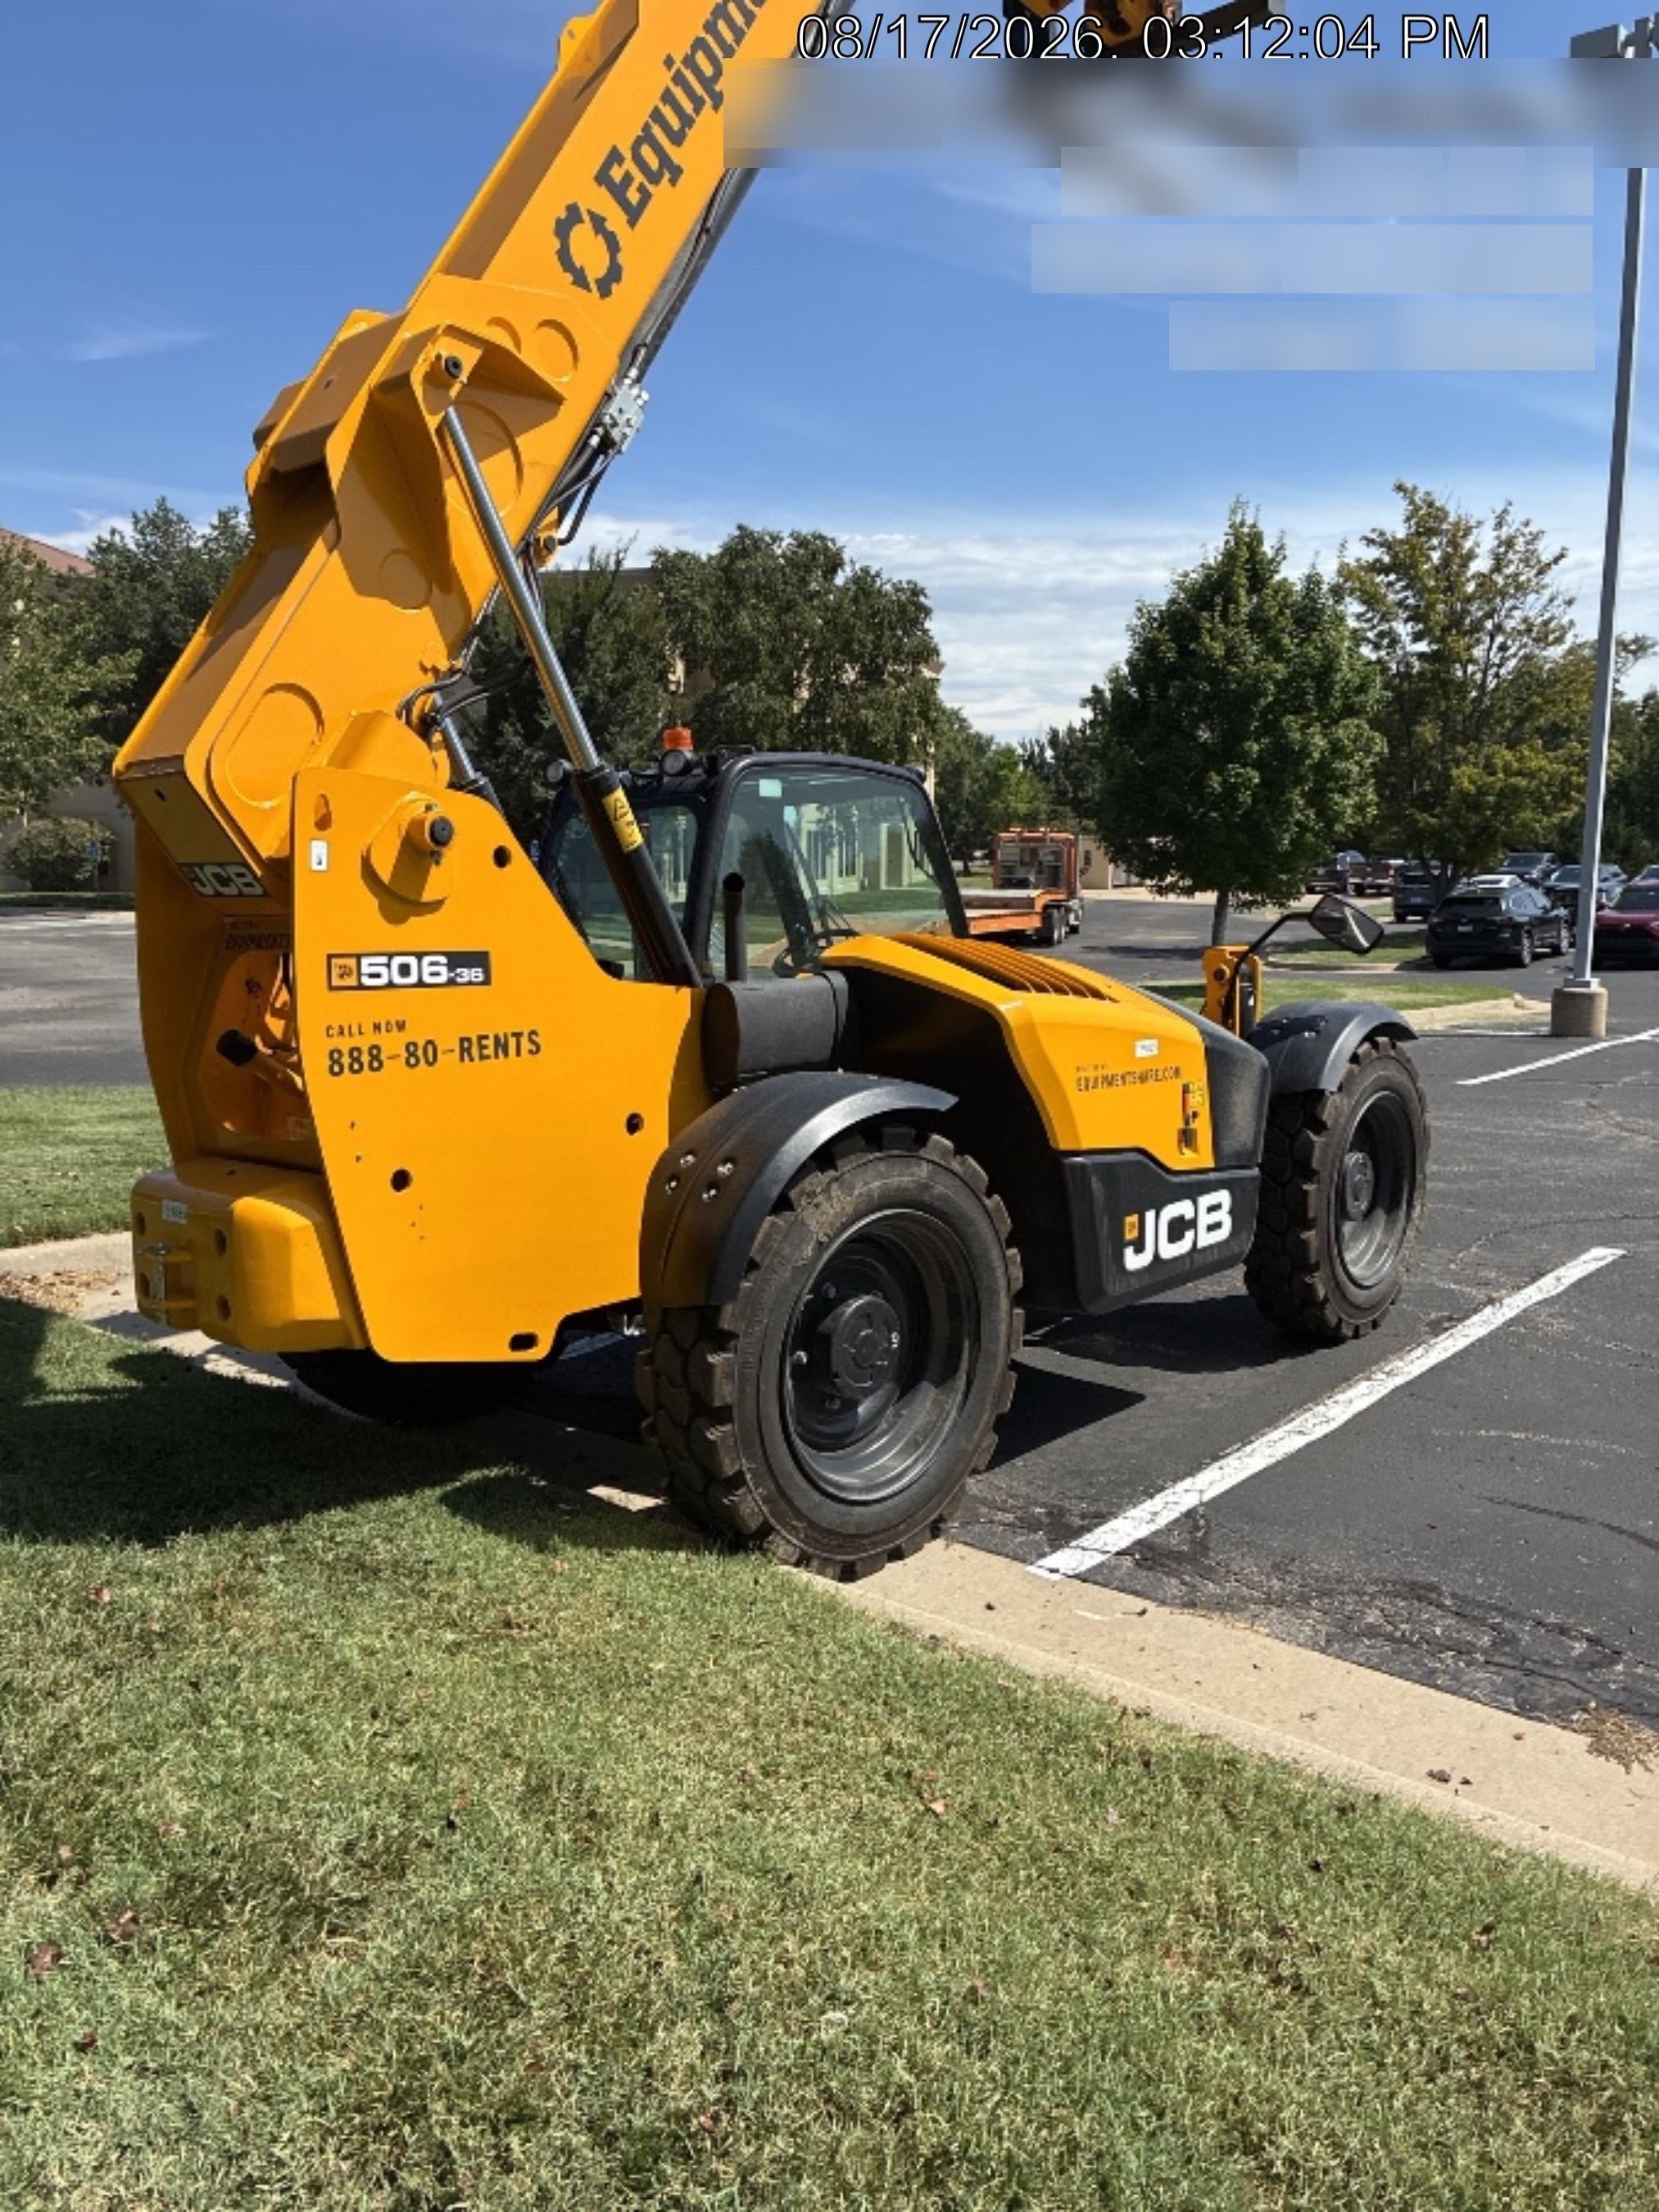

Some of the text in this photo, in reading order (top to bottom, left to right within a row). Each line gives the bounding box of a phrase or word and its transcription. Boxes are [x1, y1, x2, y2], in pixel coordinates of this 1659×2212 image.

[594, 0, 765, 229] Equipm
[193, 864, 264, 895] JCB
[360, 954, 485, 987] 506-36
[326, 1019, 406, 1038] CALL NOW
[328, 1029, 541, 1077] 888-80-RENTS
[1123, 1189, 1232, 1271] JCB
